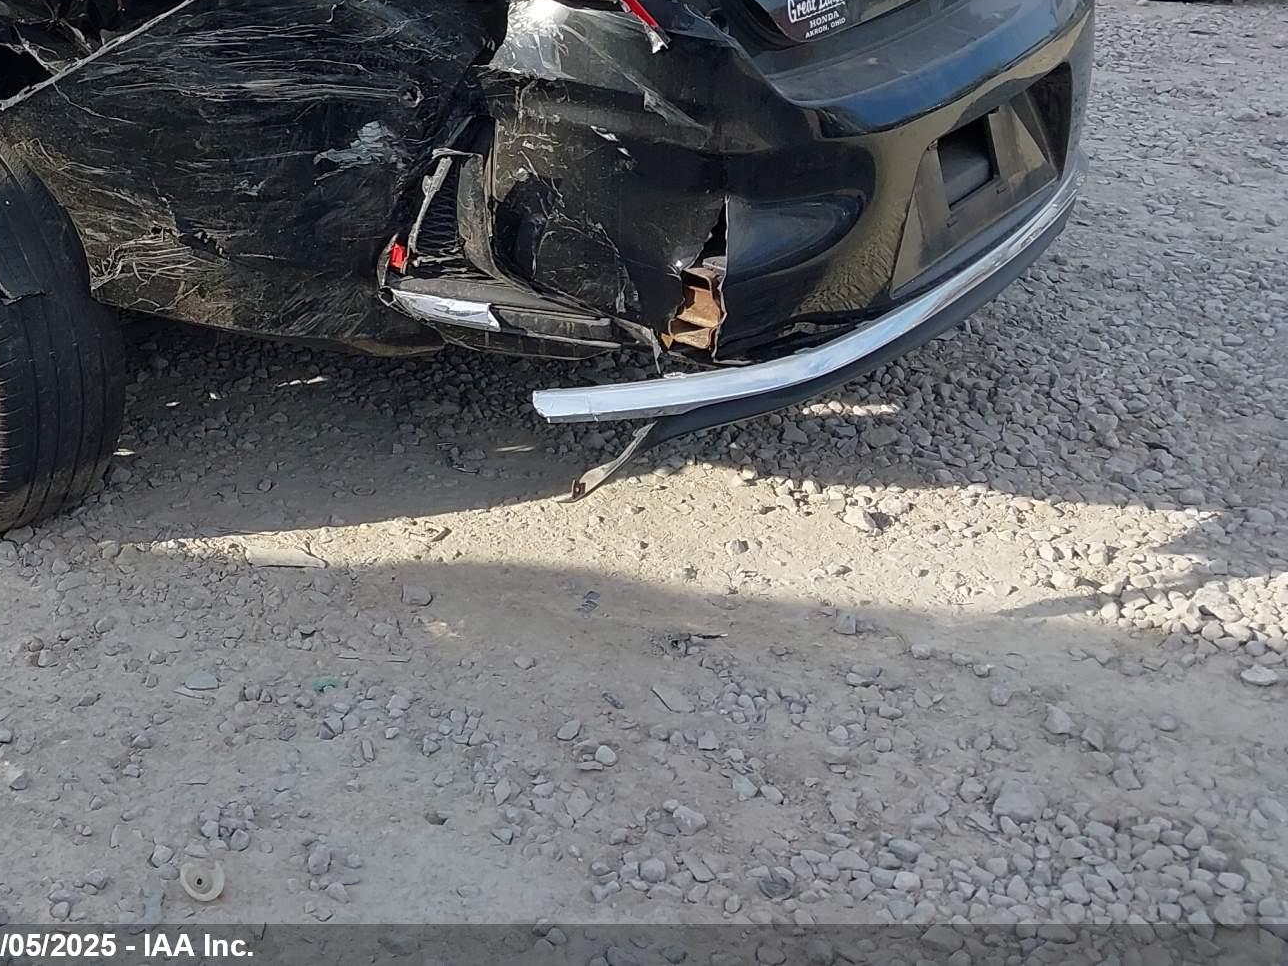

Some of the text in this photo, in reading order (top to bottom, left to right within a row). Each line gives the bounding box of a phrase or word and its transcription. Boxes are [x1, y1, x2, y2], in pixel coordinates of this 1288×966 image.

[805, 17, 846, 38] AKRON, OHIO
[809, 10, 840, 28] HONDA
